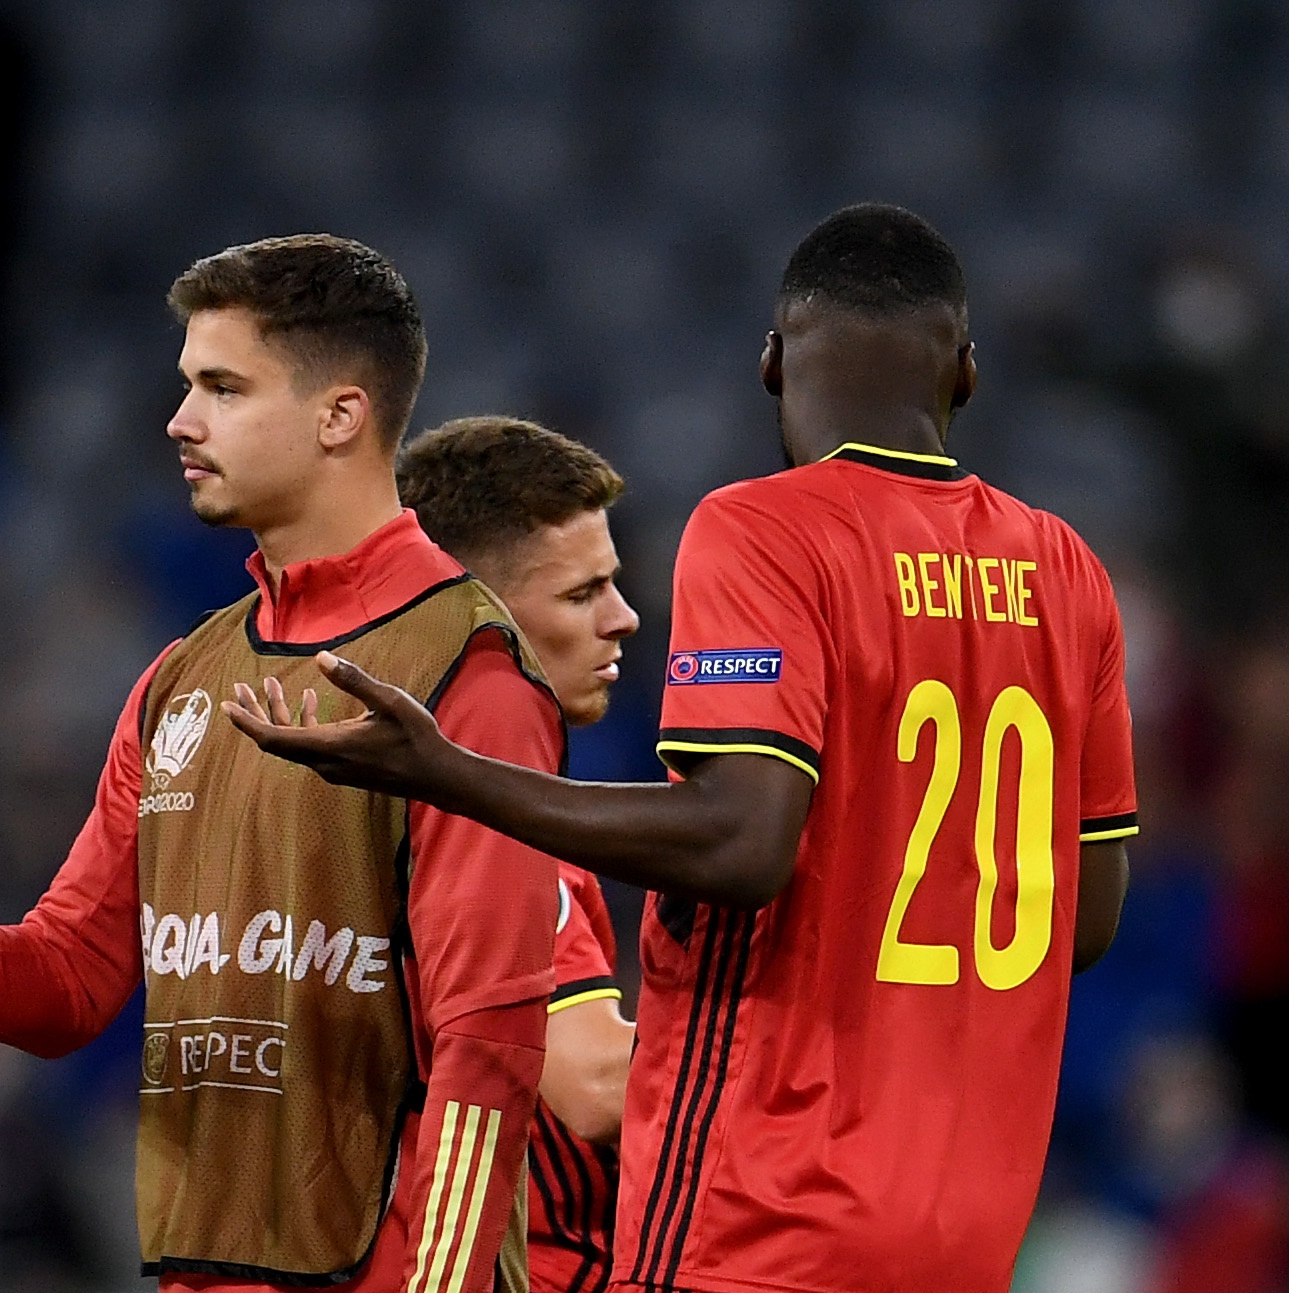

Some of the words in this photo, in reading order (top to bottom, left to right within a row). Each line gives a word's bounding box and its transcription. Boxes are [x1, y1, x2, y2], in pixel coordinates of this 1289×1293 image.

[700, 657, 781, 675] RESPECT
[876, 679, 1055, 991] 20
[181, 1031, 287, 1078] REPEC
